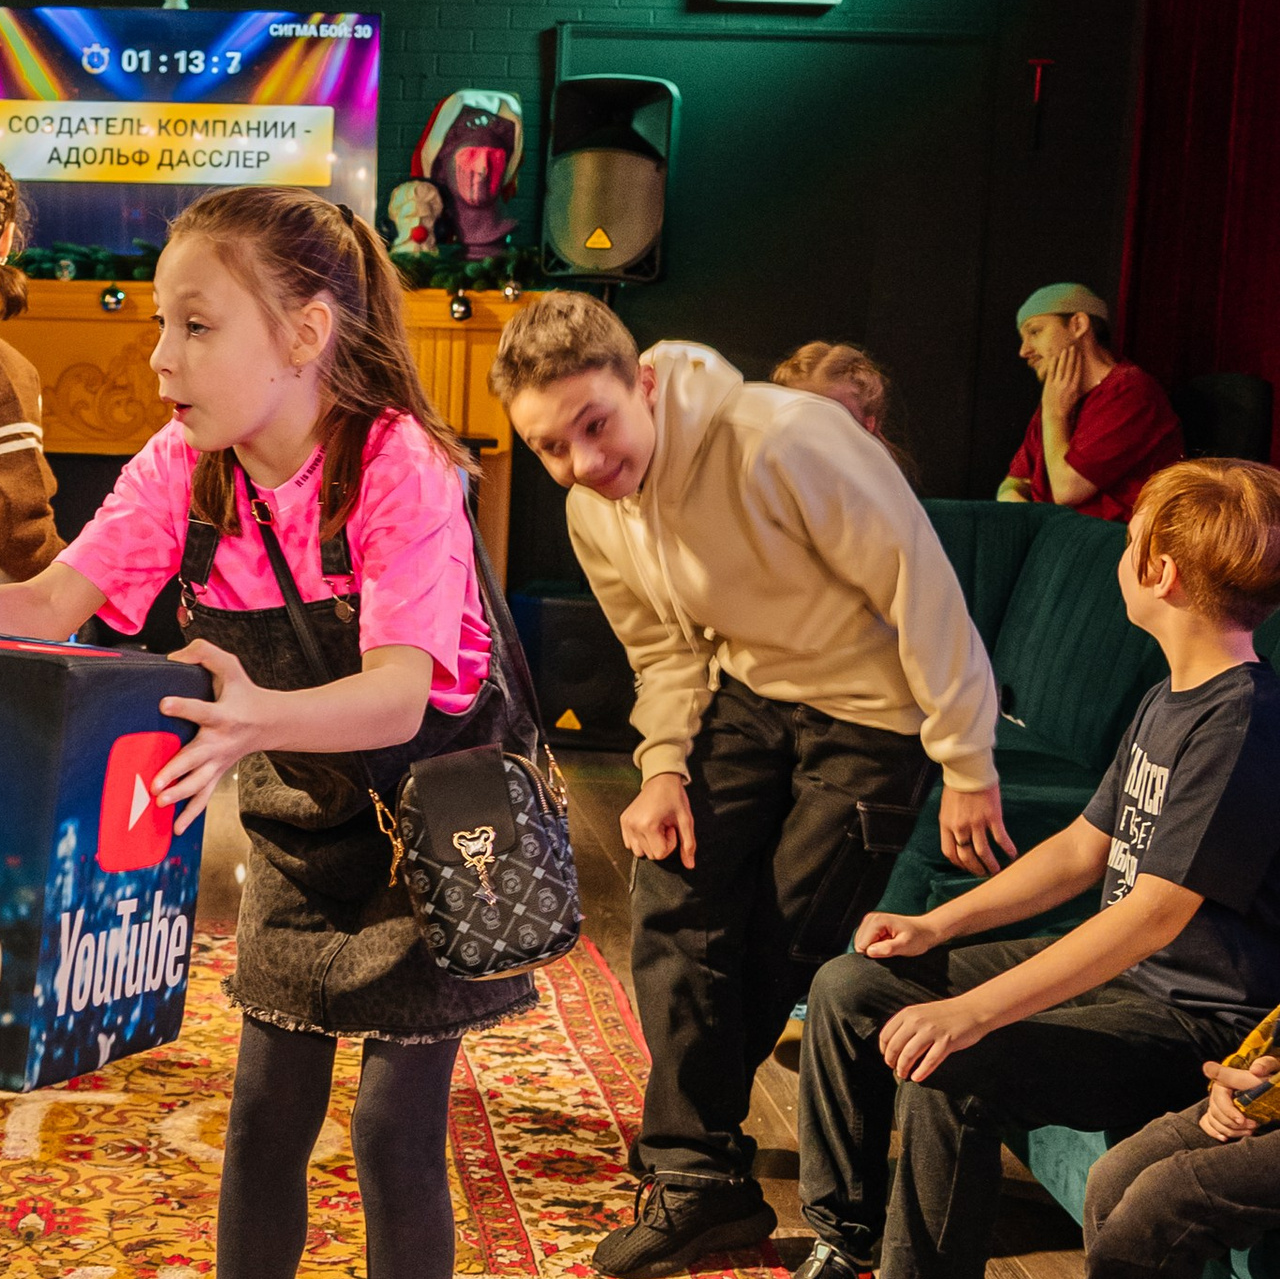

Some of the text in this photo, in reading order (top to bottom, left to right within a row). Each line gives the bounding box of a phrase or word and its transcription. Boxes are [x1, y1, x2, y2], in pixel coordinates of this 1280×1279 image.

[269, 23, 318, 38] СИГМА
[354, 25, 373, 39] 30
[8, 115, 152, 139] СОЗДАТЕЛЬ
[157, 118, 297, 140] КОМПАНИИ
[47, 146, 271, 171] АДОЛЬФ ДАССЛЕР
[56, 890, 189, 1017] YouTube
